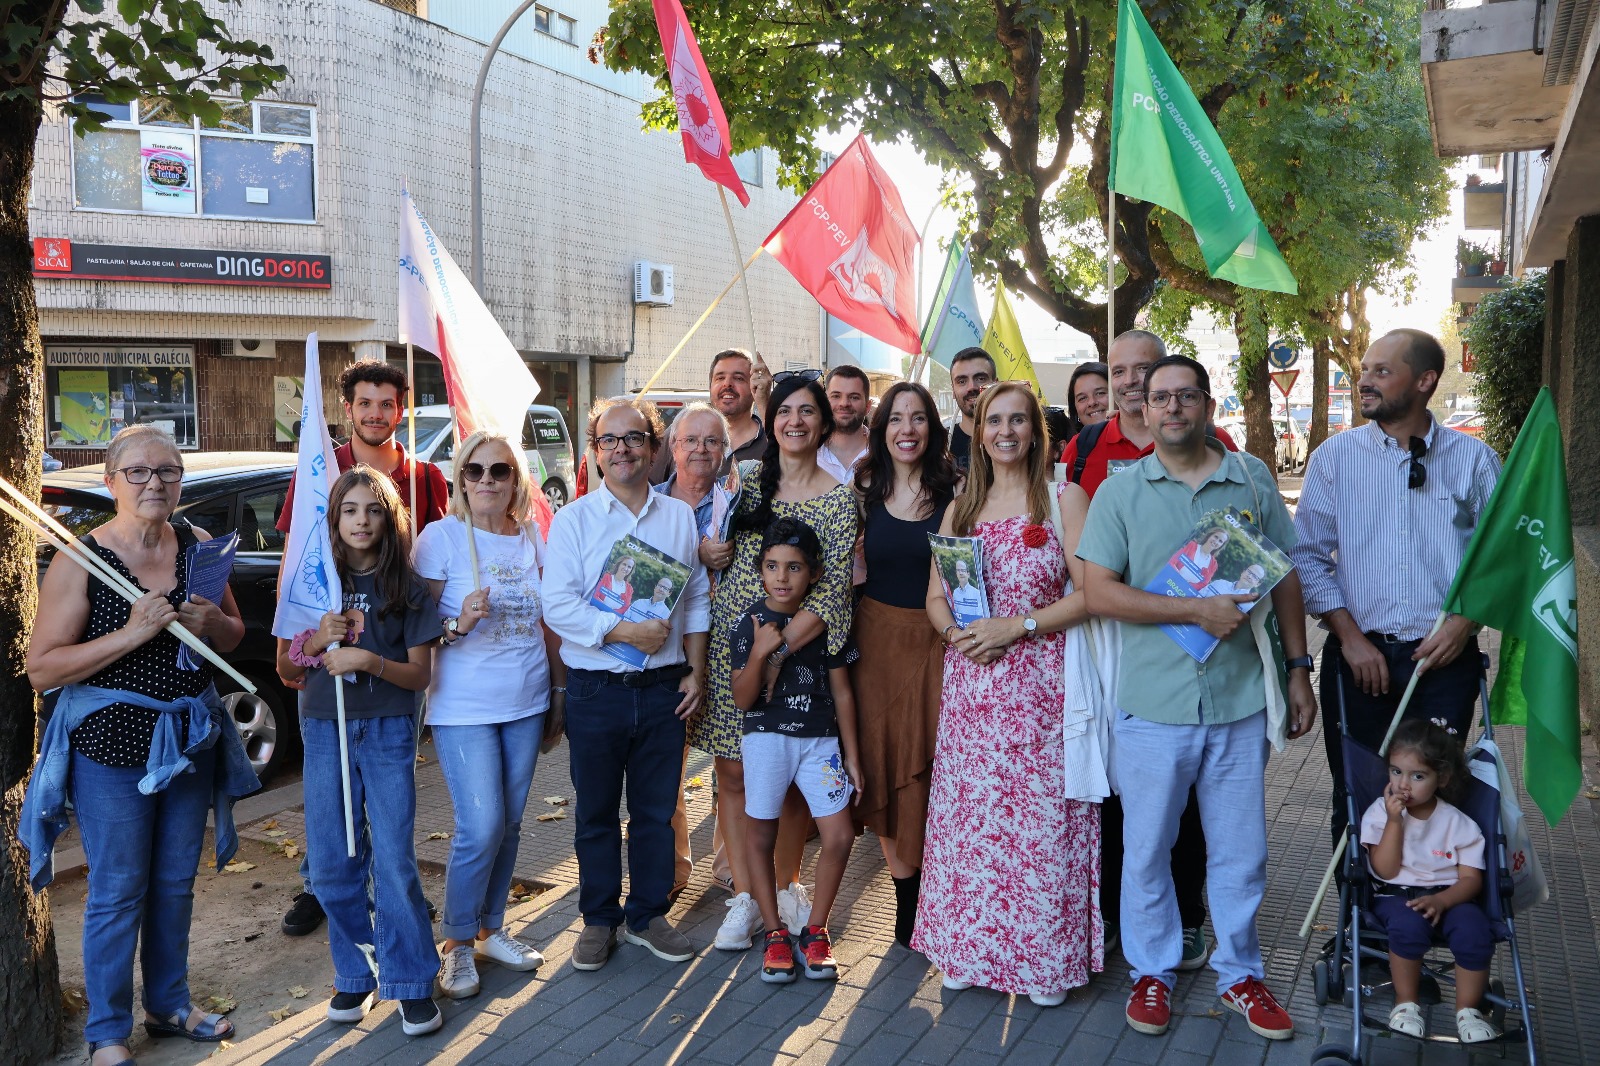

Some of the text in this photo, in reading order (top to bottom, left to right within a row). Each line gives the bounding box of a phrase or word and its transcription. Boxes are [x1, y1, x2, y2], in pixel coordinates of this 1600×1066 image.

[1147, 62, 1236, 212] GAÇÃO DEMOCRÁTICA UNITÁRIA
[156, 170, 180, 179] Tattoo
[807, 197, 850, 247] PCP-PEV
[38, 257, 69, 269] SICAL
[86, 257, 125, 265] PASTELARIA
[129, 258, 151, 267] SALÃO
[180, 261, 213, 269] CAFETARIA
[50, 348, 190, 365] AUDITÓRIO MUNICIPAL GALÉCIA
[540, 429, 559, 438] TRATA
[1224, 514, 1241, 528] CDU
[626, 542, 642, 553] CDU
